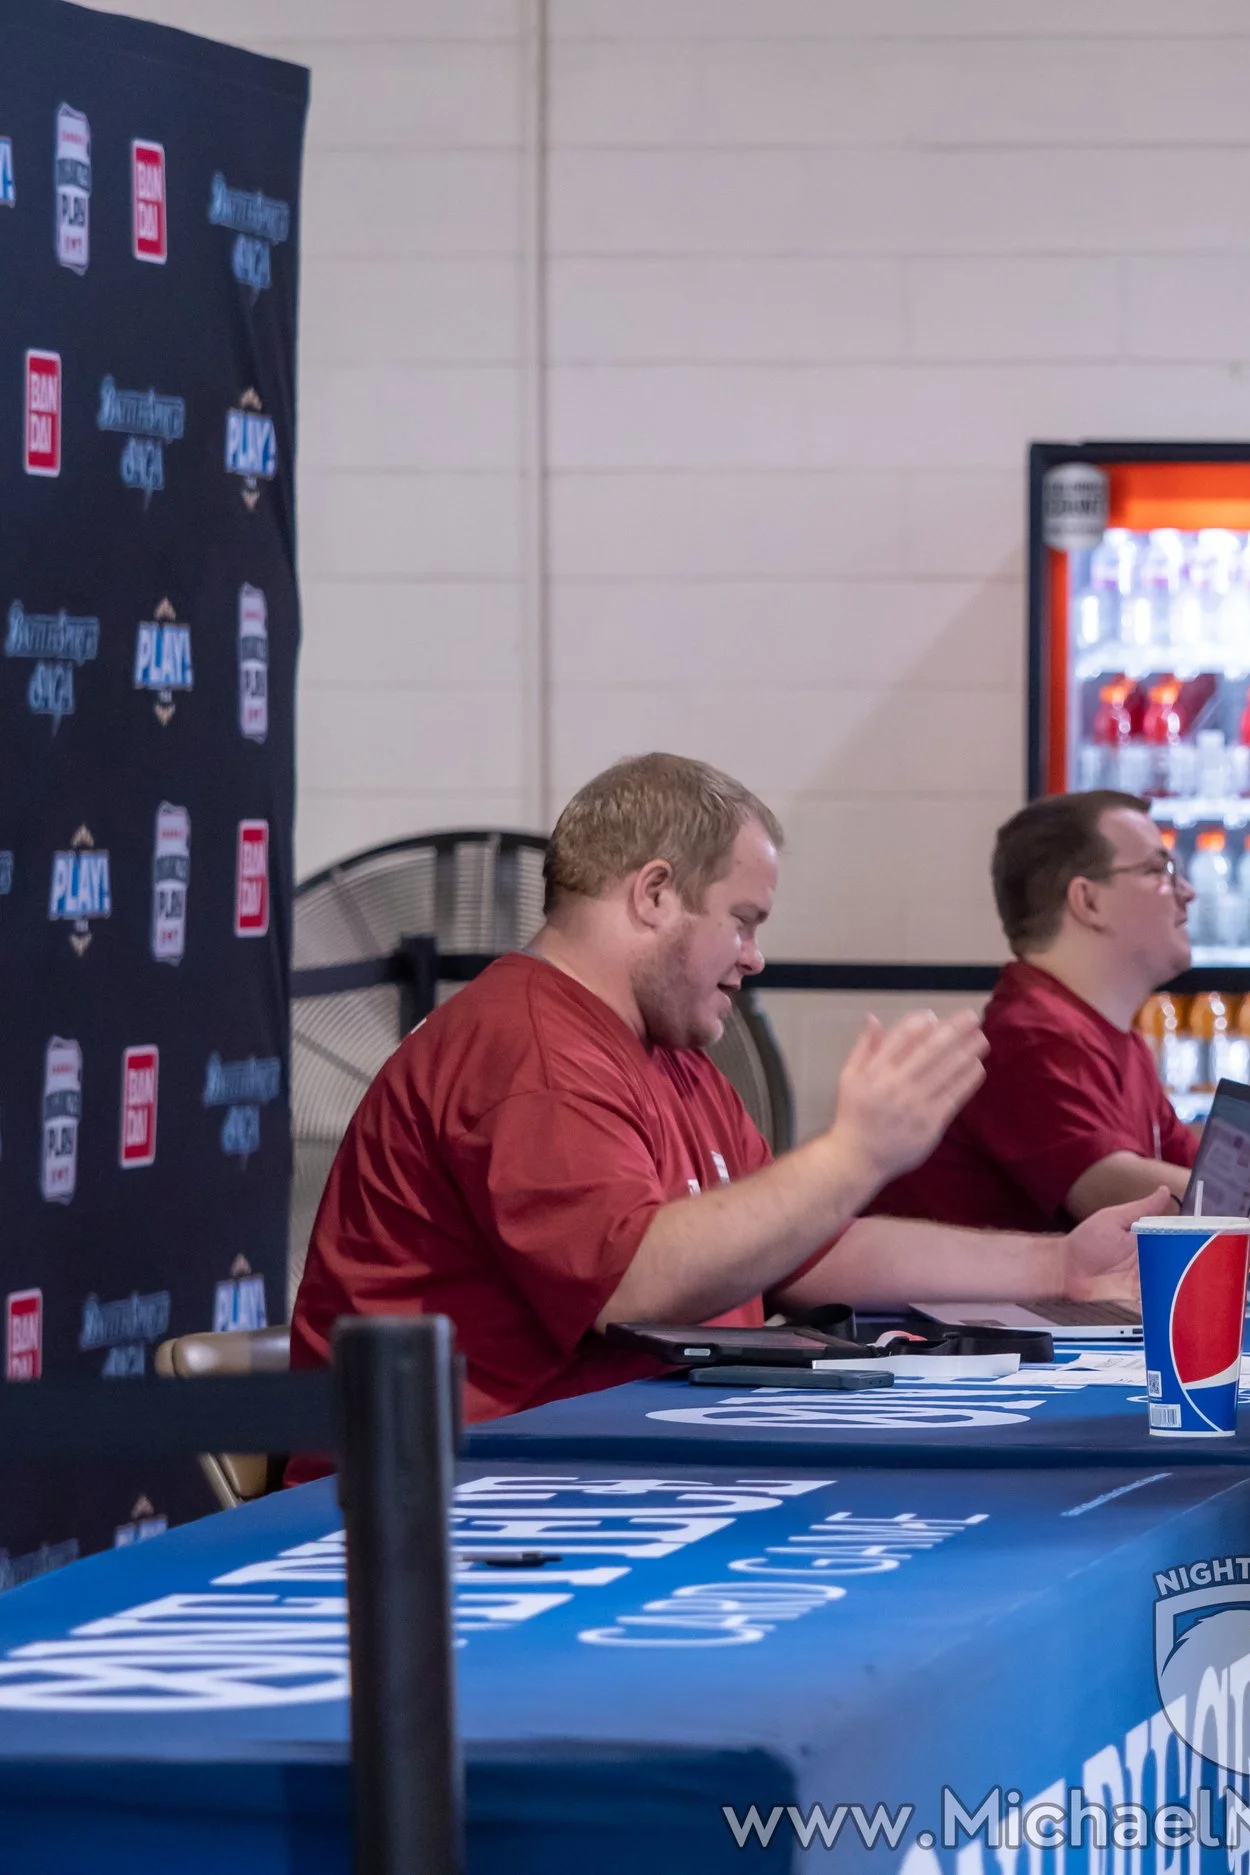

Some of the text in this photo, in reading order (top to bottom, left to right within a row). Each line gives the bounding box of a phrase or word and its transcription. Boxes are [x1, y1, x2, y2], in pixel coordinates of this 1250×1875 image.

[137, 162, 163, 200] BAN
[137, 202, 160, 241] DAI
[29, 372, 58, 412] BAN
[29, 415, 53, 454] DAI
[51, 856, 110, 917] PLAY!
[127, 1068, 155, 1104] BAN
[125, 1106, 149, 1147] DAI
[11, 1313, 39, 1353] BAN
[576, 1511, 990, 1648] CARD GAME
